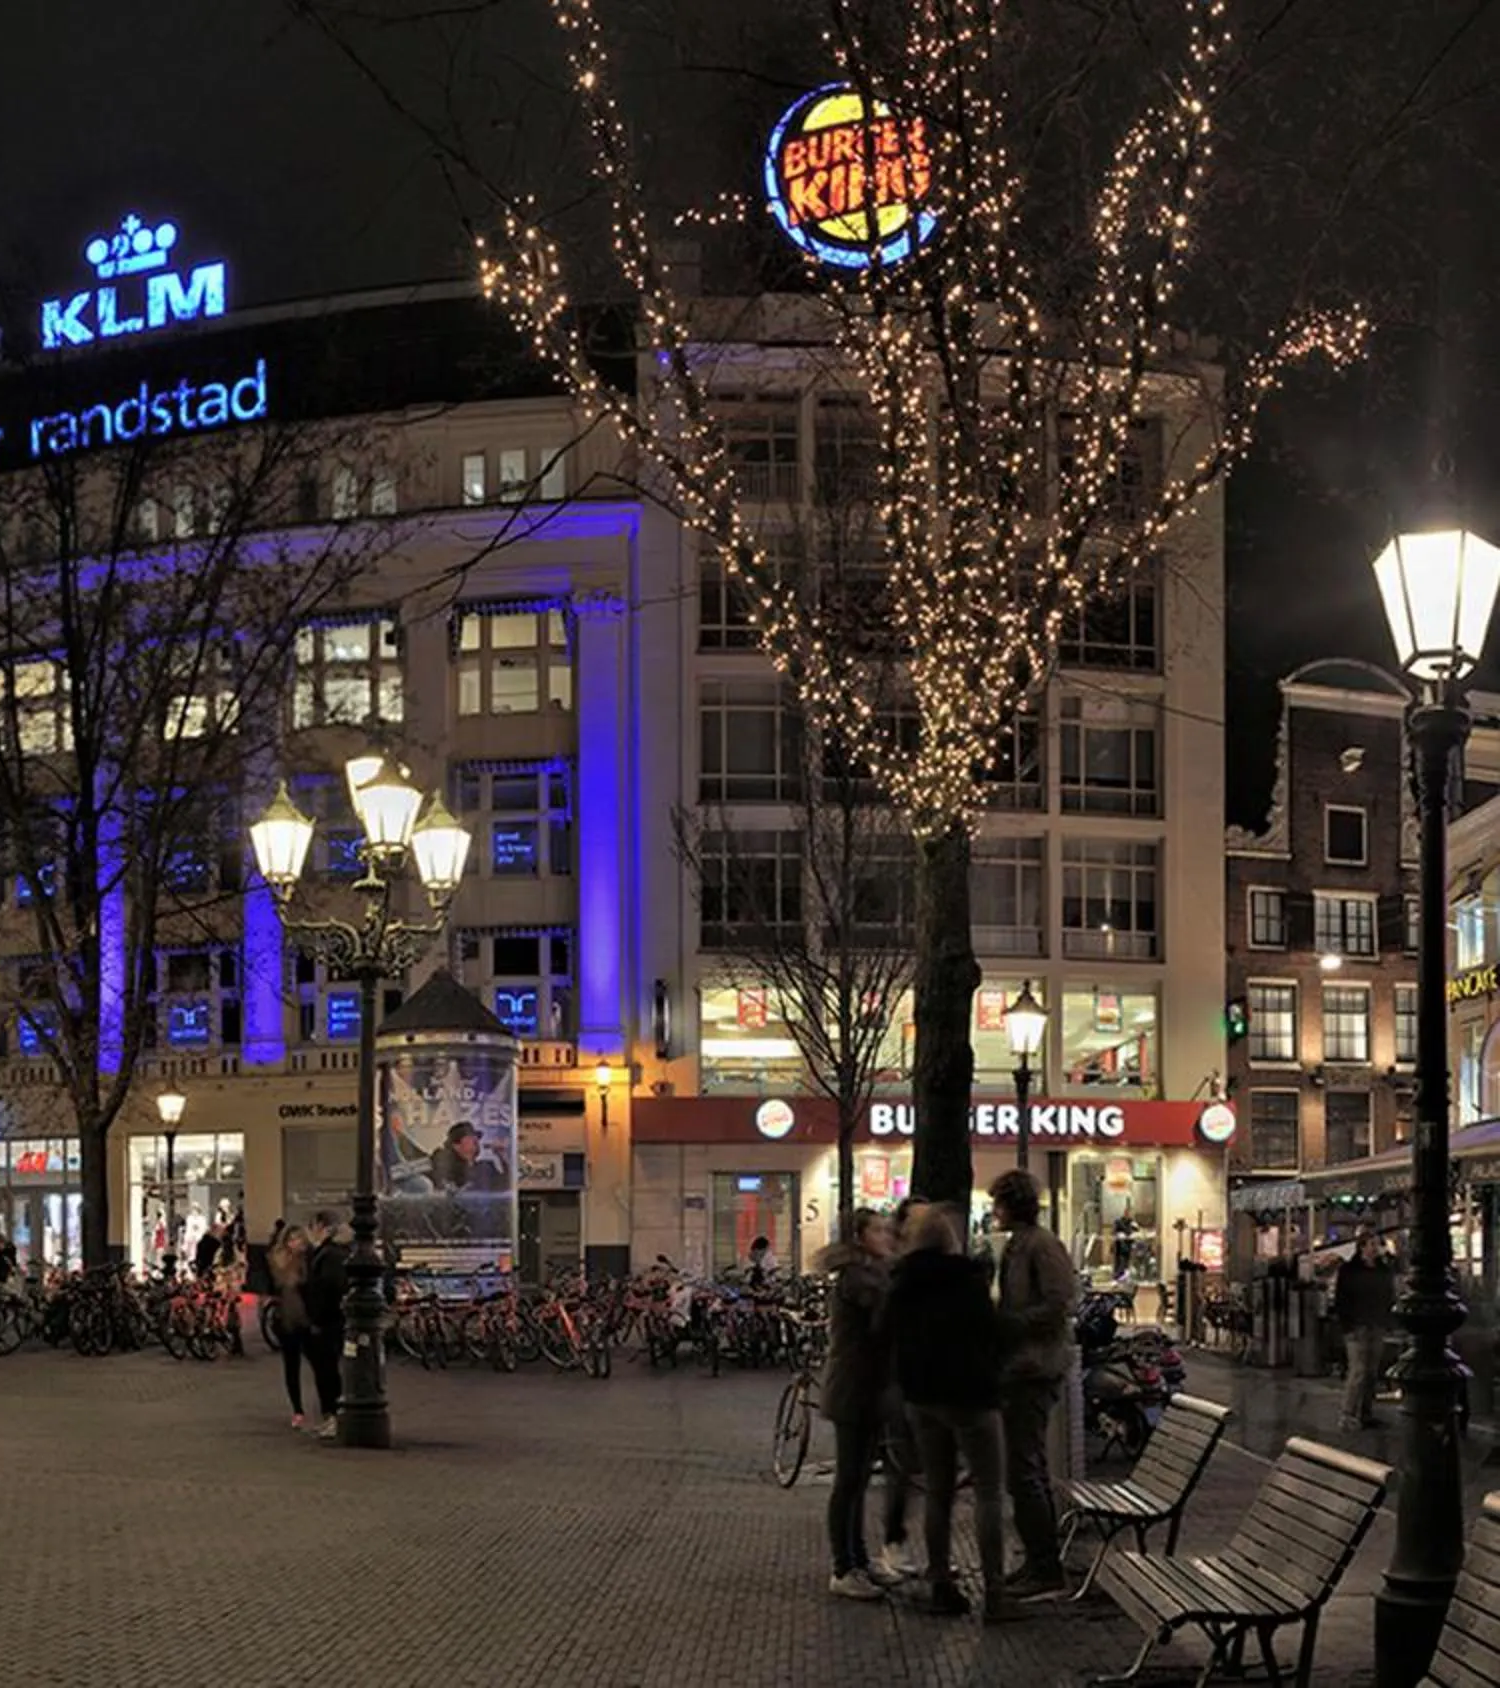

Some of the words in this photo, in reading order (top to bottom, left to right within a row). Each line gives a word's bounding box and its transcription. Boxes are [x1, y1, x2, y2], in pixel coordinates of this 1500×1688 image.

[41, 261, 225, 349] KLM
[29, 357, 268, 458] randstad
[869, 1103, 1019, 1135] BUER
[1030, 1105, 1125, 1137] KING
[804, 1198, 820, 1222] 5
